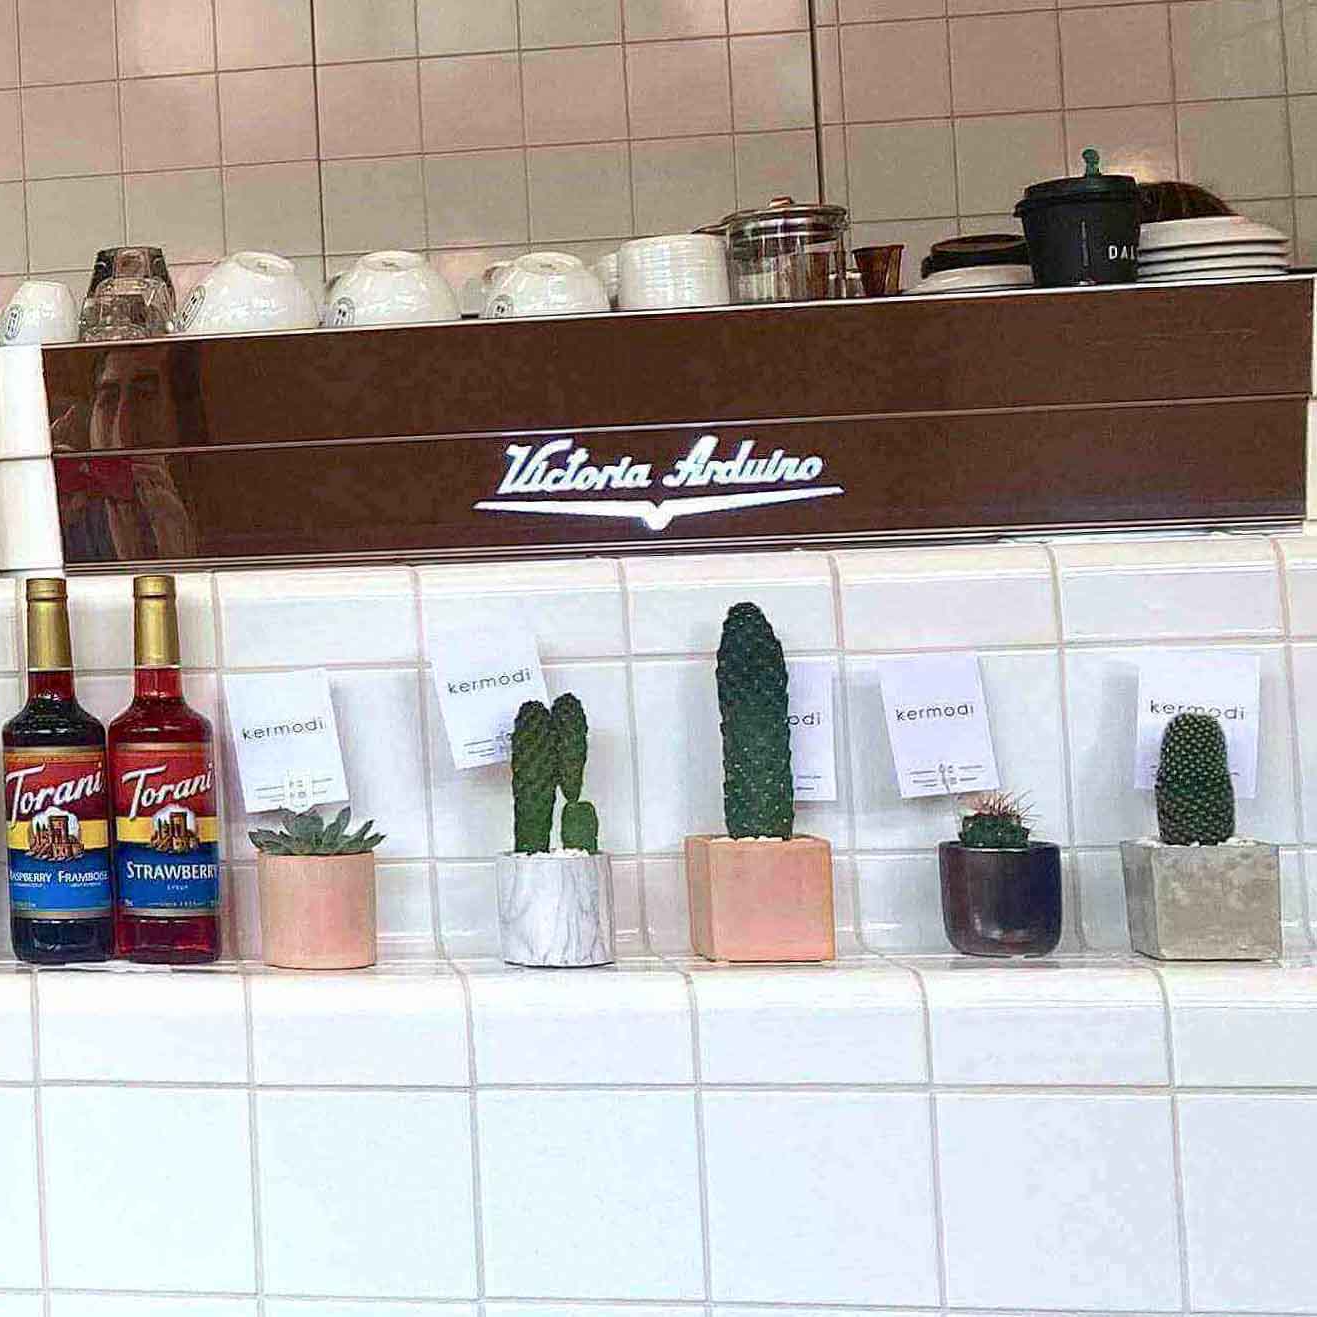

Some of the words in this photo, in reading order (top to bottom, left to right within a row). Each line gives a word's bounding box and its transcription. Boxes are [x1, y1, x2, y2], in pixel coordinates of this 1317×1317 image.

[497, 438, 653, 494] Victoria
[662, 435, 822, 488] Arduino
[447, 668, 531, 694] kermodi
[242, 719, 327, 740] kermodi
[895, 703, 974, 721] kermodi
[6, 762, 103, 829] Torani
[121, 762, 214, 822] Torani
